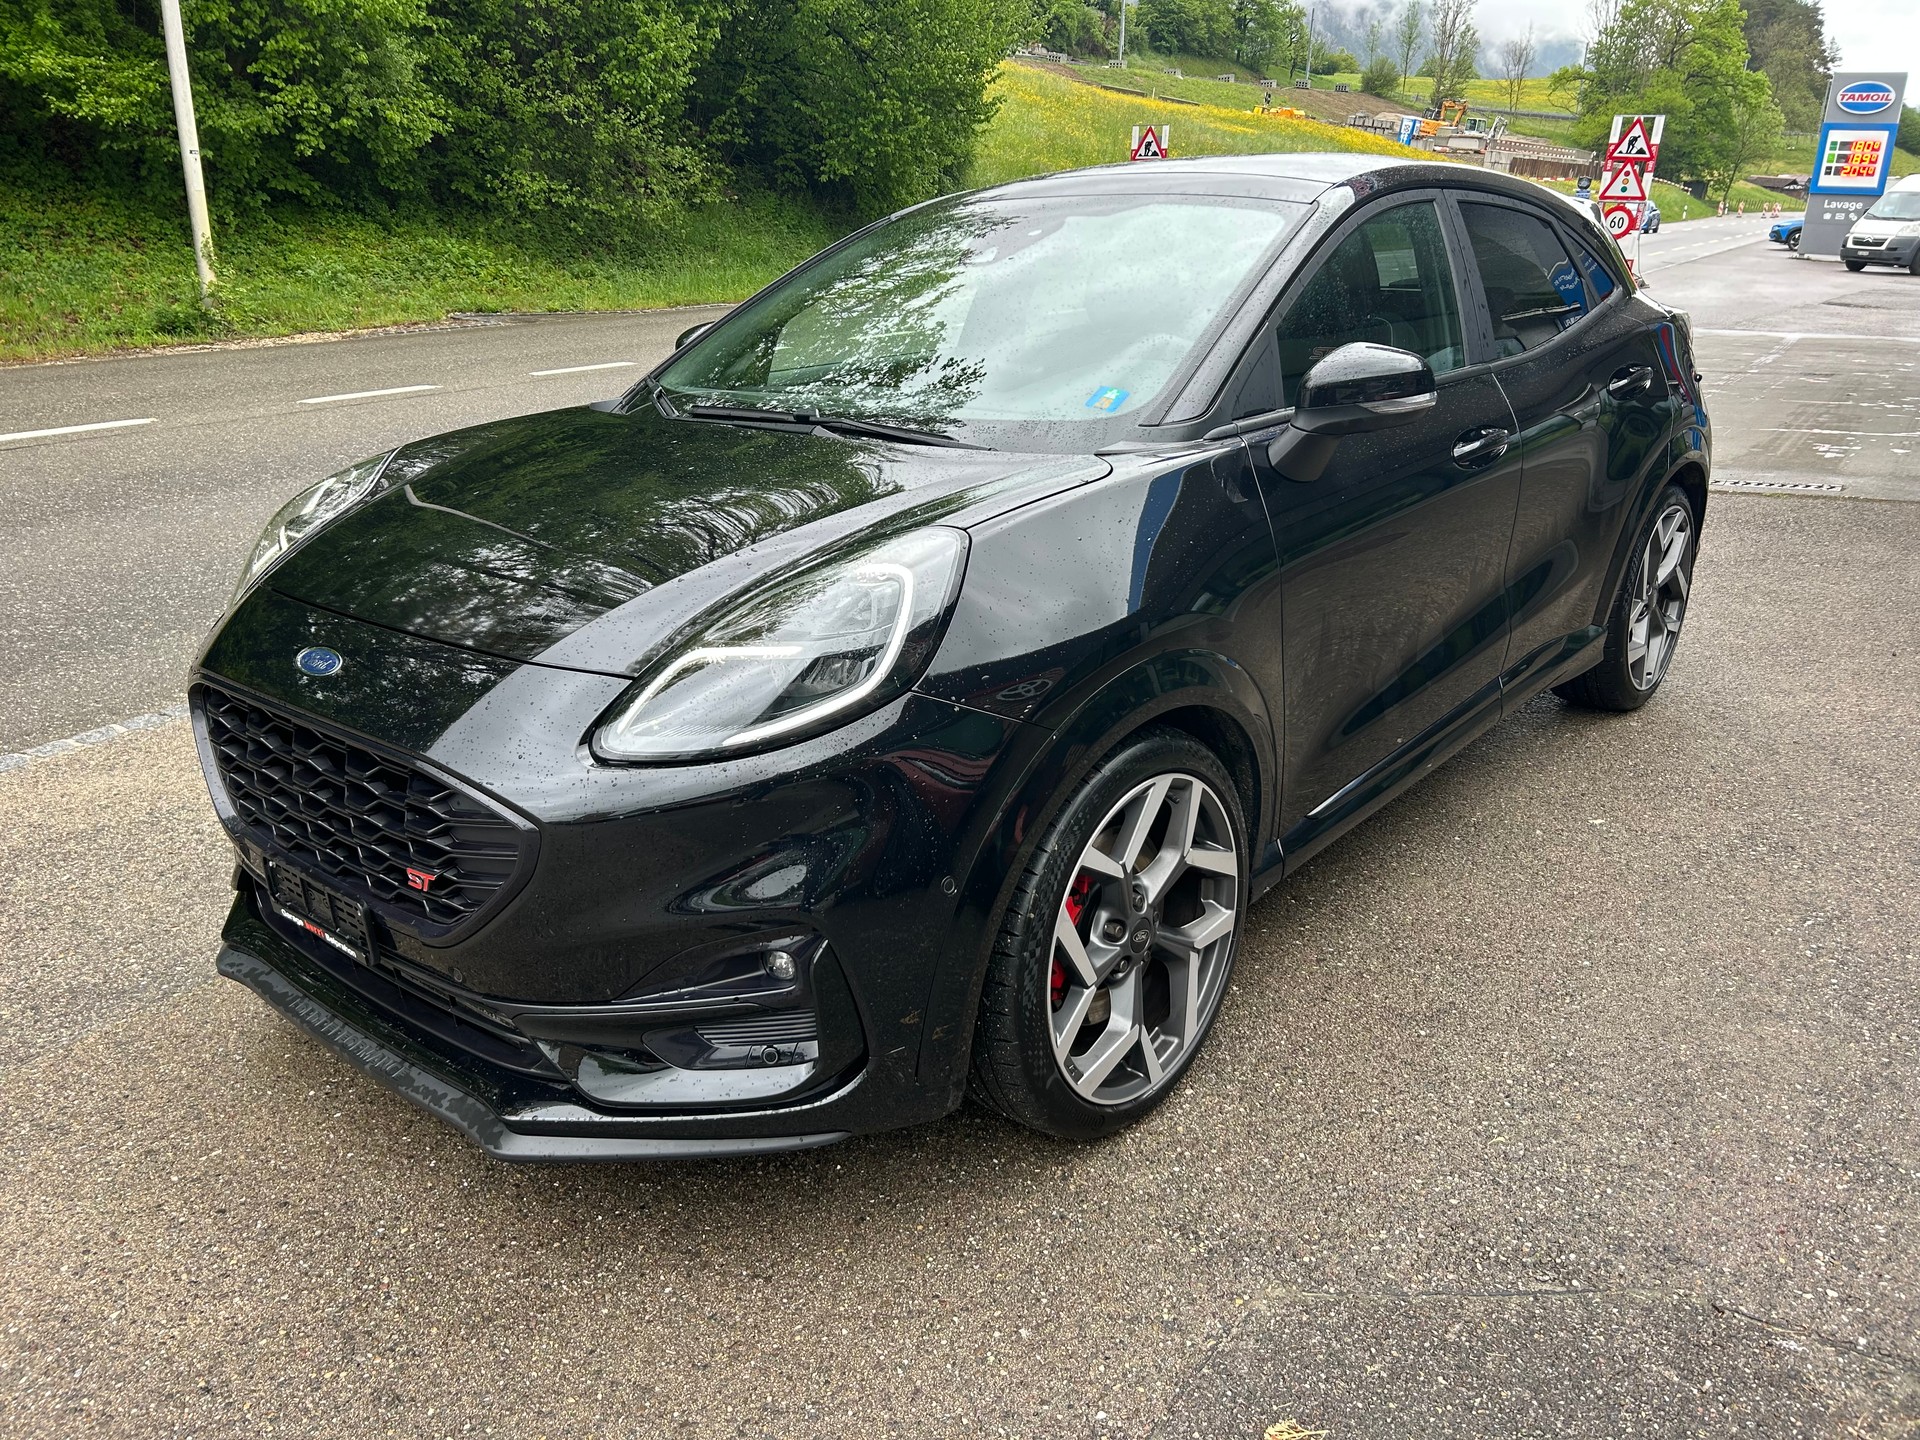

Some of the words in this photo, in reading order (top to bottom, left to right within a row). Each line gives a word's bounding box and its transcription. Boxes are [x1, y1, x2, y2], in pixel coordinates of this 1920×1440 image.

[1839, 93, 1893, 102] TAMOIL
[1823, 199, 1863, 211] Lavage
[1609, 216, 1625, 229] 60
[406, 867, 436, 892] ST
